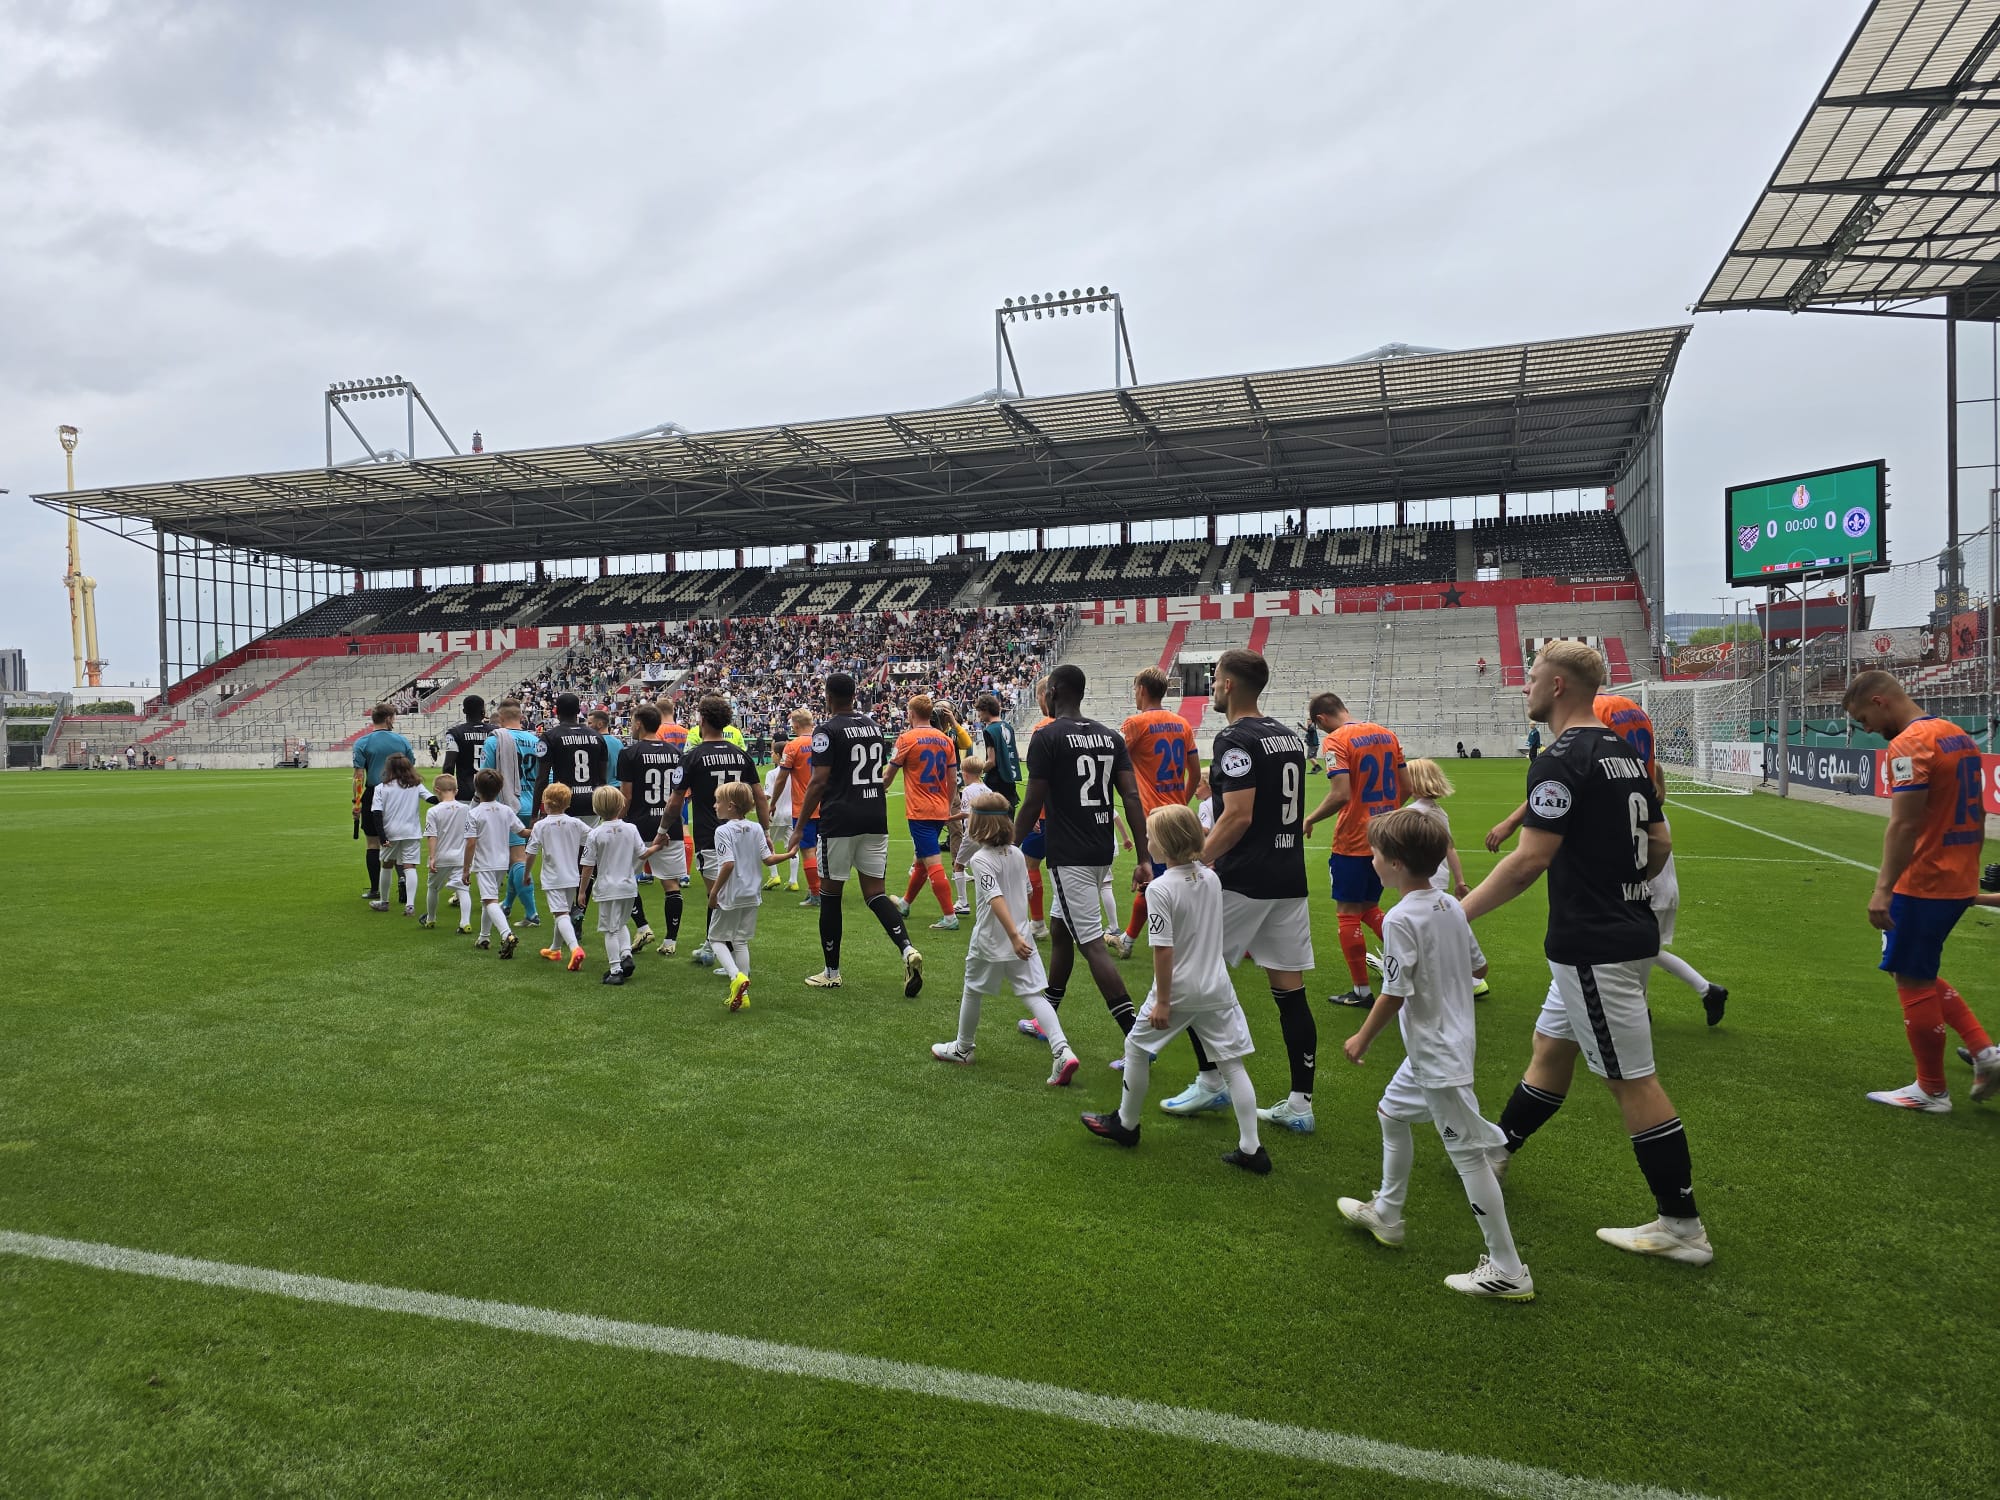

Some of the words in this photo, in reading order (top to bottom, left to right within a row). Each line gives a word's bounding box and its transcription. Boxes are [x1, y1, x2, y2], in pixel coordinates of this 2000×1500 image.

[1767, 520, 1778, 539] 0
[1785, 517, 1818, 533] 00:00
[1825, 511, 1837, 530] 0
[770, 576, 934, 617] 1910
[418, 628, 516, 652] KEIN
[561, 735, 589, 746] TEUTONIA
[1066, 734, 1103, 749] TEUTONIA
[1260, 735, 1297, 755] TEUTONIA
[1350, 733, 1394, 749] DARMSTADT
[574, 749, 590, 783] 8
[643, 753, 673, 764] TEUTONIA
[702, 754, 734, 767] TEUTONIA
[851, 743, 884, 785] 22
[1154, 738, 1185, 782] 29
[1225, 758, 1250, 772] L&B
[645, 768, 674, 805] 30
[1076, 754, 1115, 807] 27
[1359, 751, 1397, 803] 26
[1282, 762, 1300, 825] 9
[1534, 797, 1568, 809] L&B
[1628, 791, 1649, 871] 6
